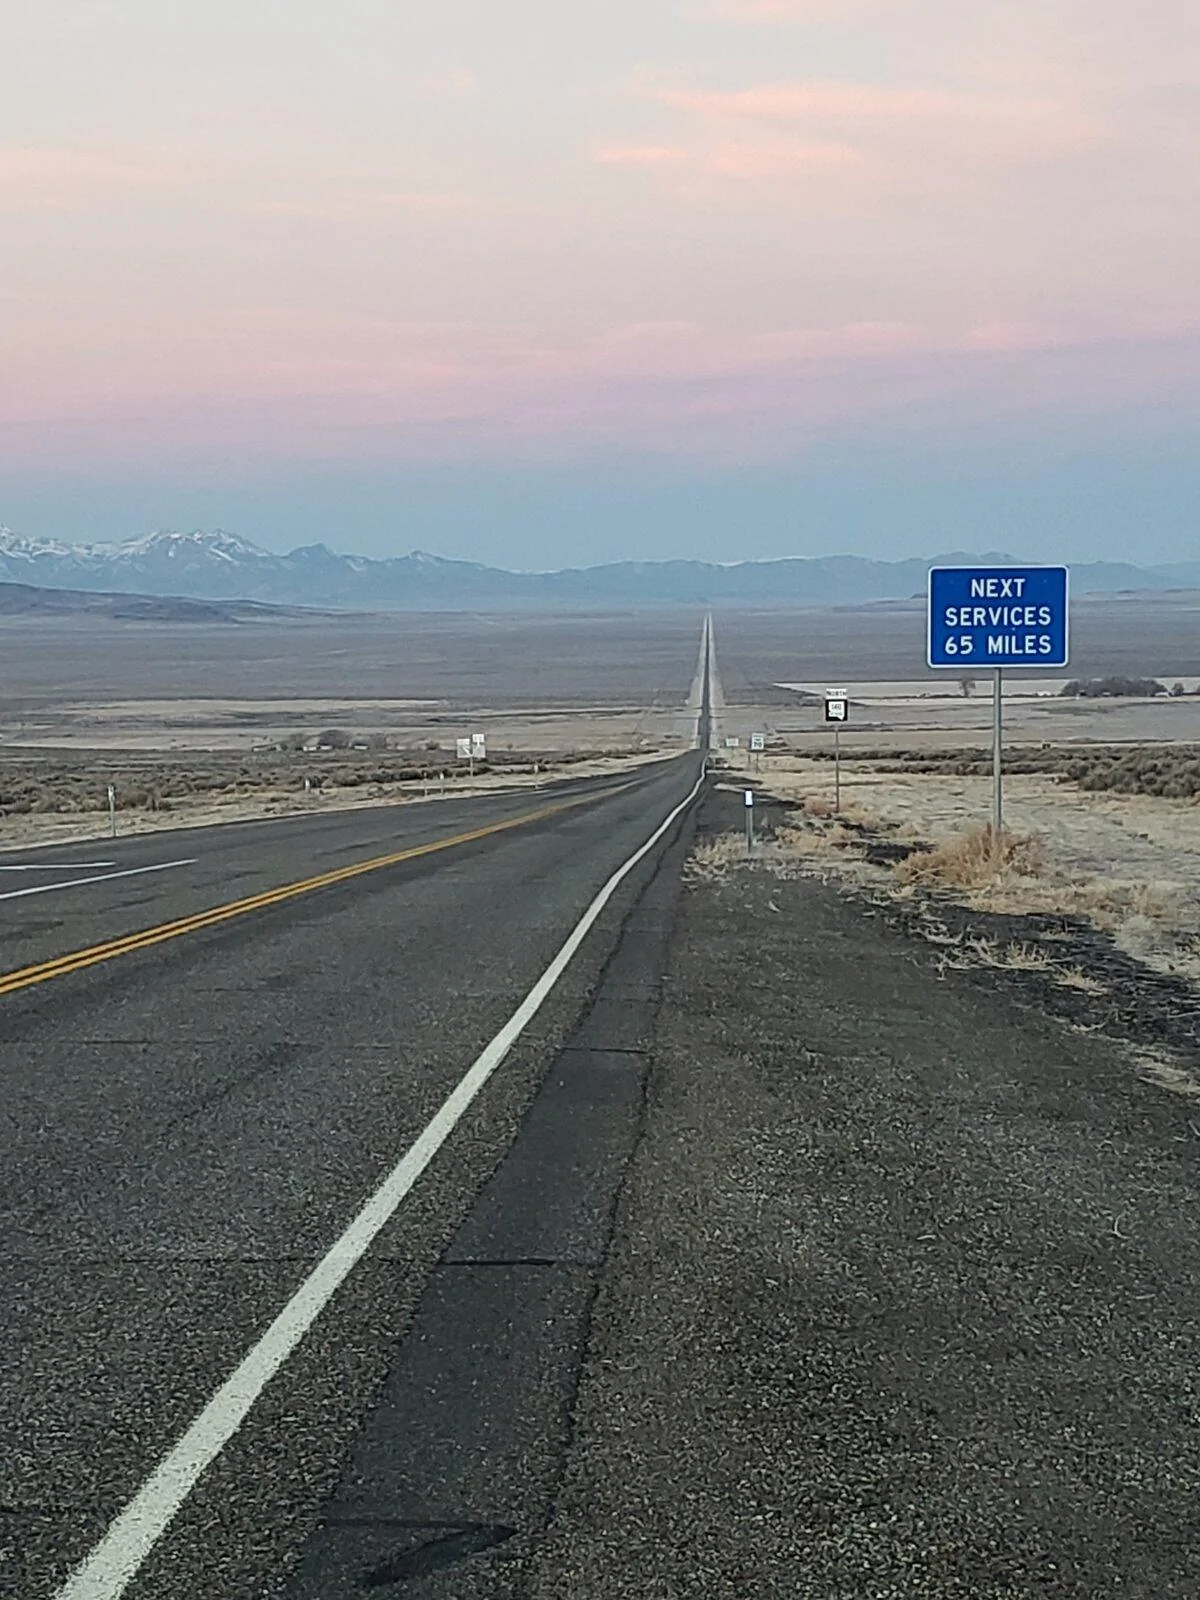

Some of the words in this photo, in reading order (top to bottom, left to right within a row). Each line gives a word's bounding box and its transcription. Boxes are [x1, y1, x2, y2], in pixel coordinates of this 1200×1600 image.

[971, 578, 1026, 598] NEXT
[944, 606, 1052, 627] SERVICES
[944, 635, 973, 655] 65
[988, 635, 1052, 655] MILES
